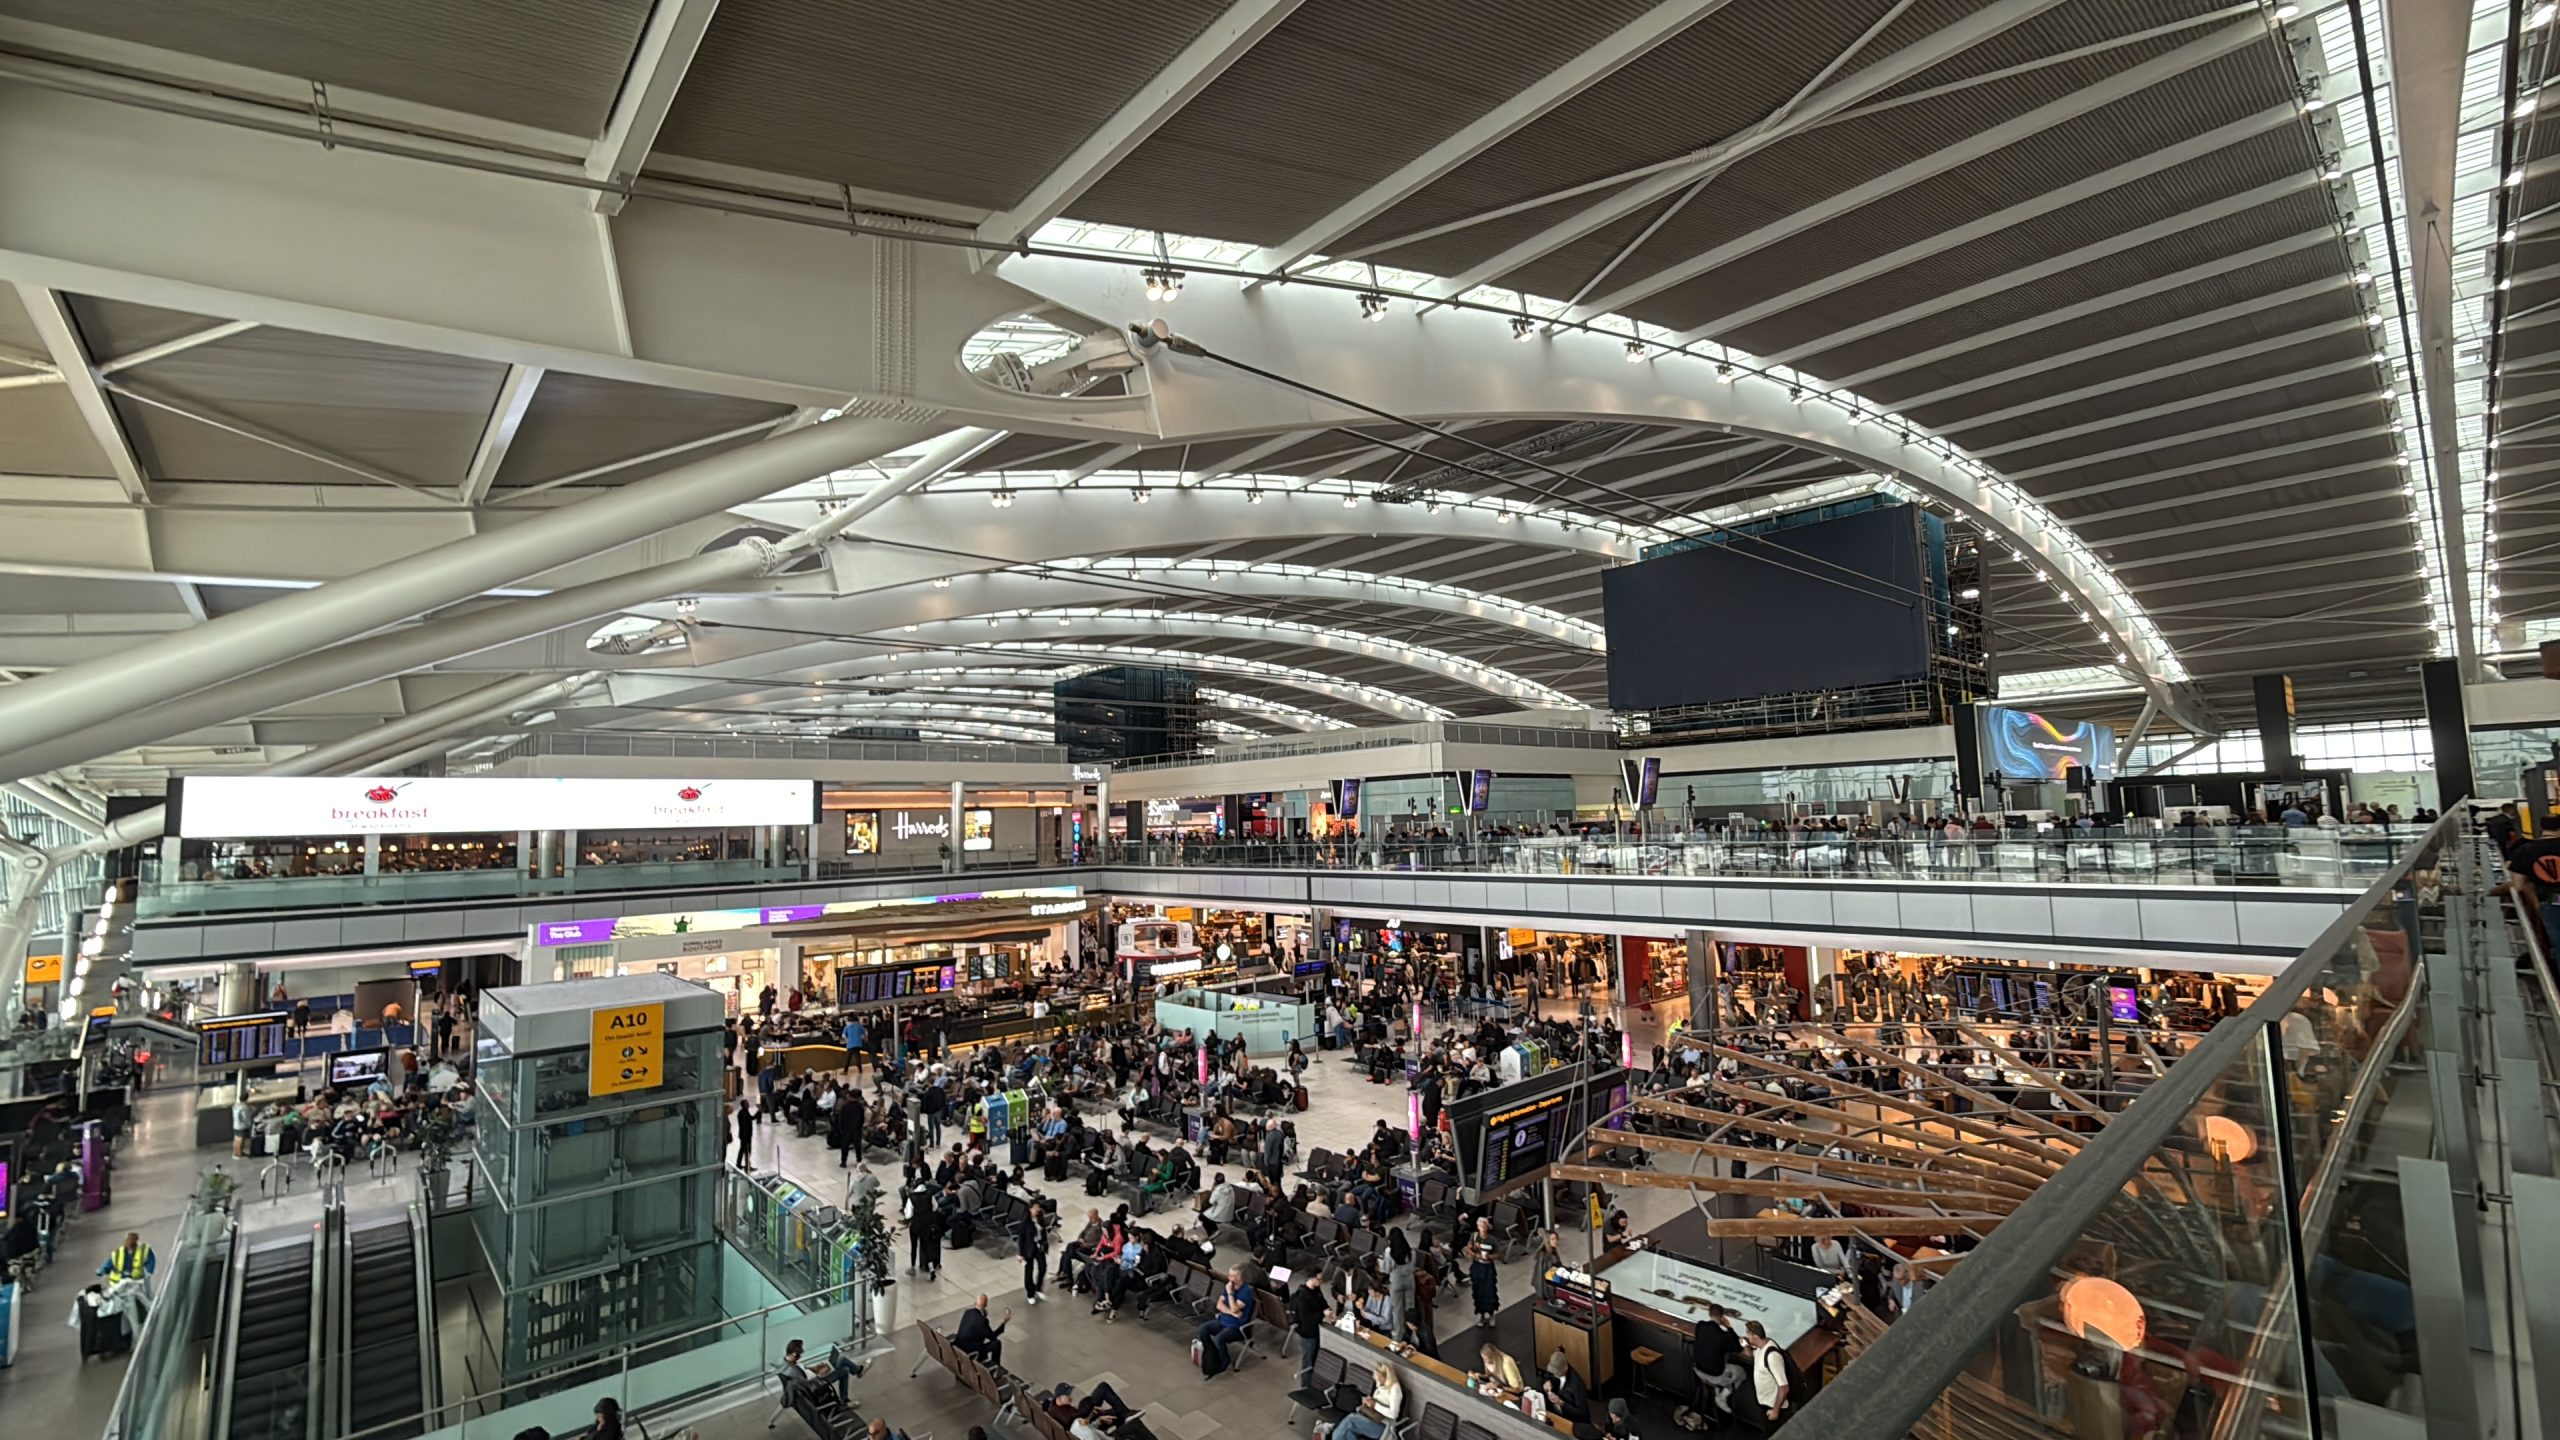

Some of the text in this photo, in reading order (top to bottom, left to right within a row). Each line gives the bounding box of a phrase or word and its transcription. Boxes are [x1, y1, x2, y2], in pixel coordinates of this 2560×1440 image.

[1072, 765, 1101, 781] Harrods
[331, 807, 428, 820] breakfast
[891, 811, 949, 840] Harrods
[549, 930, 582, 939] The Club
[683, 944, 723, 953] BOUTIQUE
[610, 1012, 647, 1029] A10
